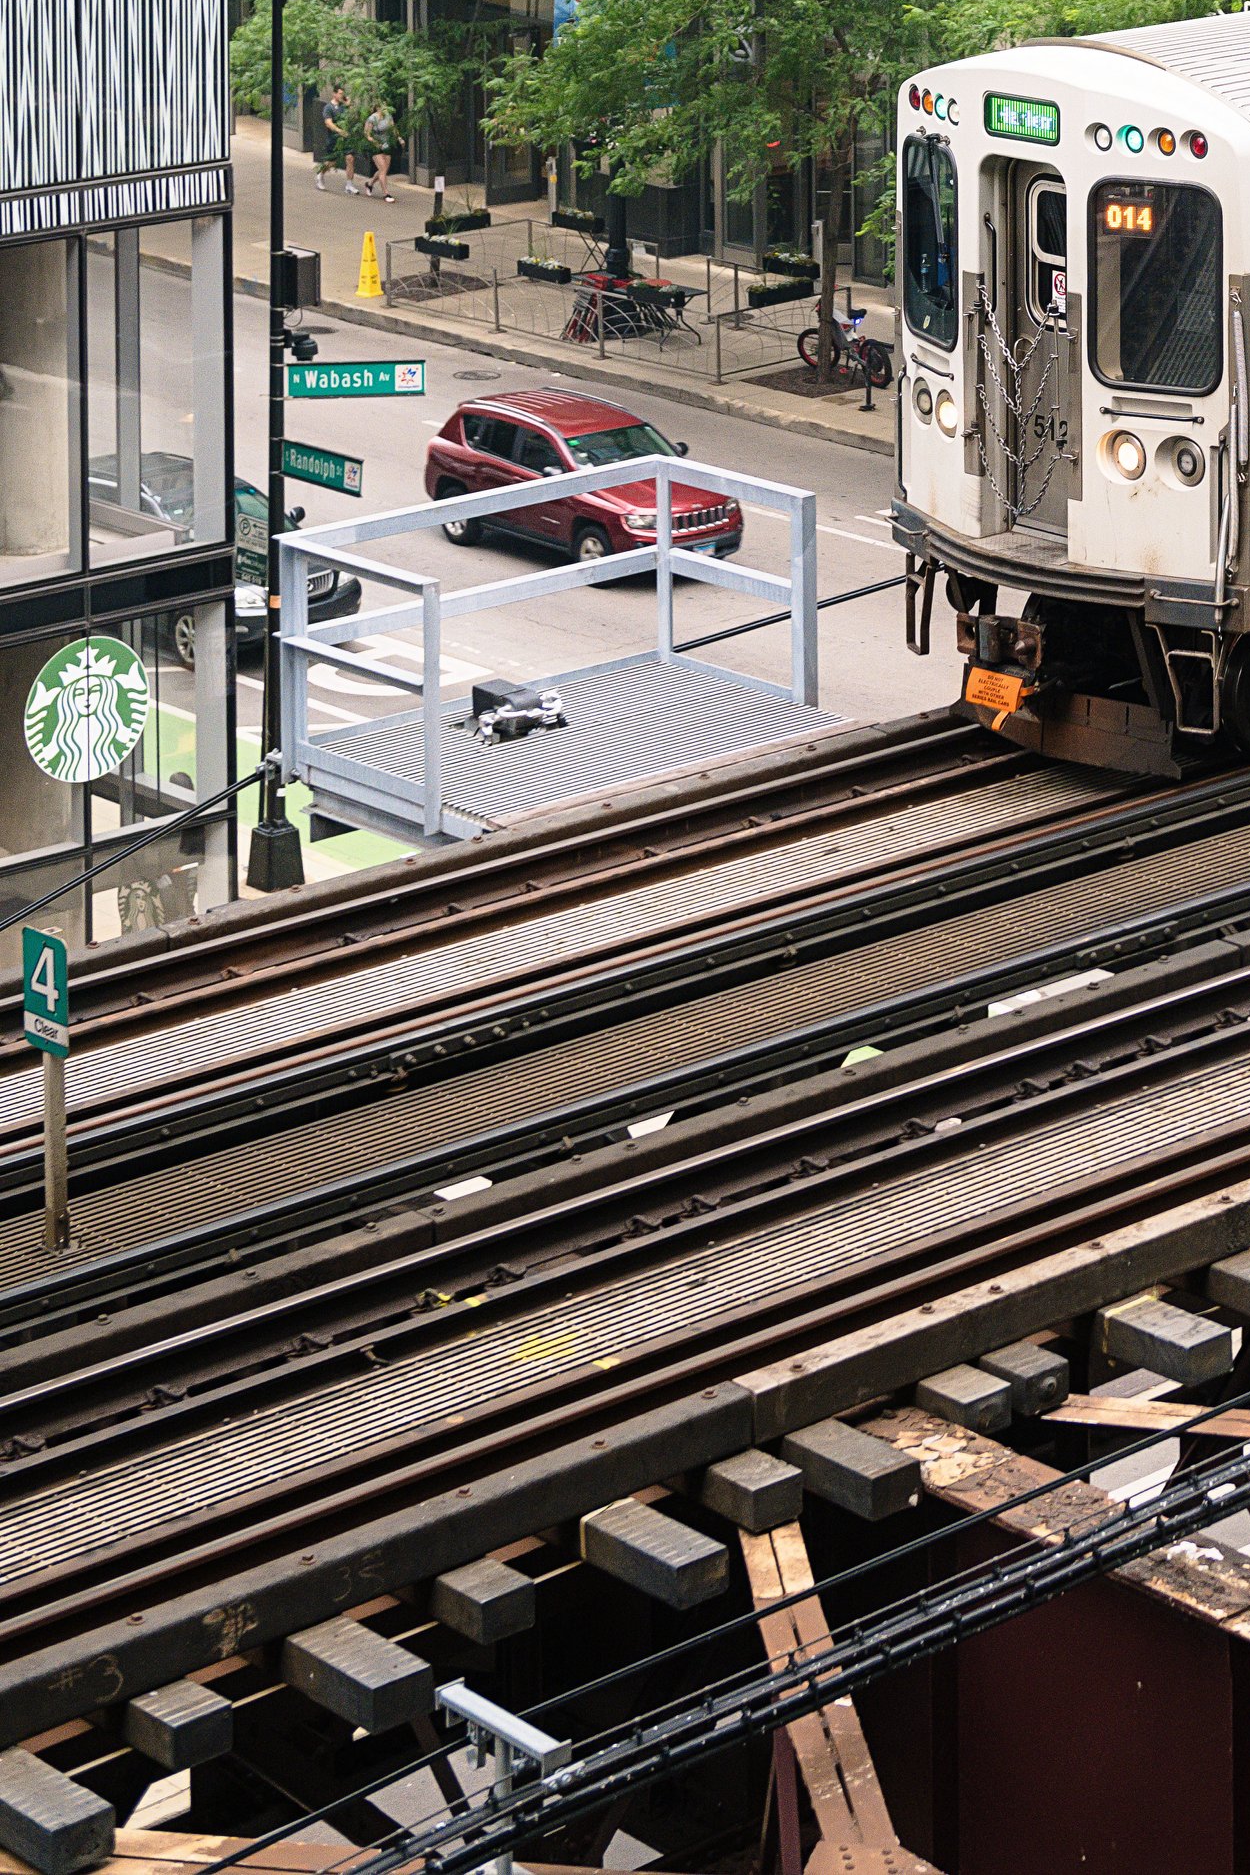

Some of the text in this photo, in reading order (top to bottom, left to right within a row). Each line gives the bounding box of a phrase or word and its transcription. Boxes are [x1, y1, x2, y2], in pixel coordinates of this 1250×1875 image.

[1106, 204, 1152, 231] 014
[293, 369, 390, 389] N Wabash Av
[290, 448, 335, 481] Randolph
[31, 946, 59, 1013] 4
[34, 1018, 59, 1039] Clear
